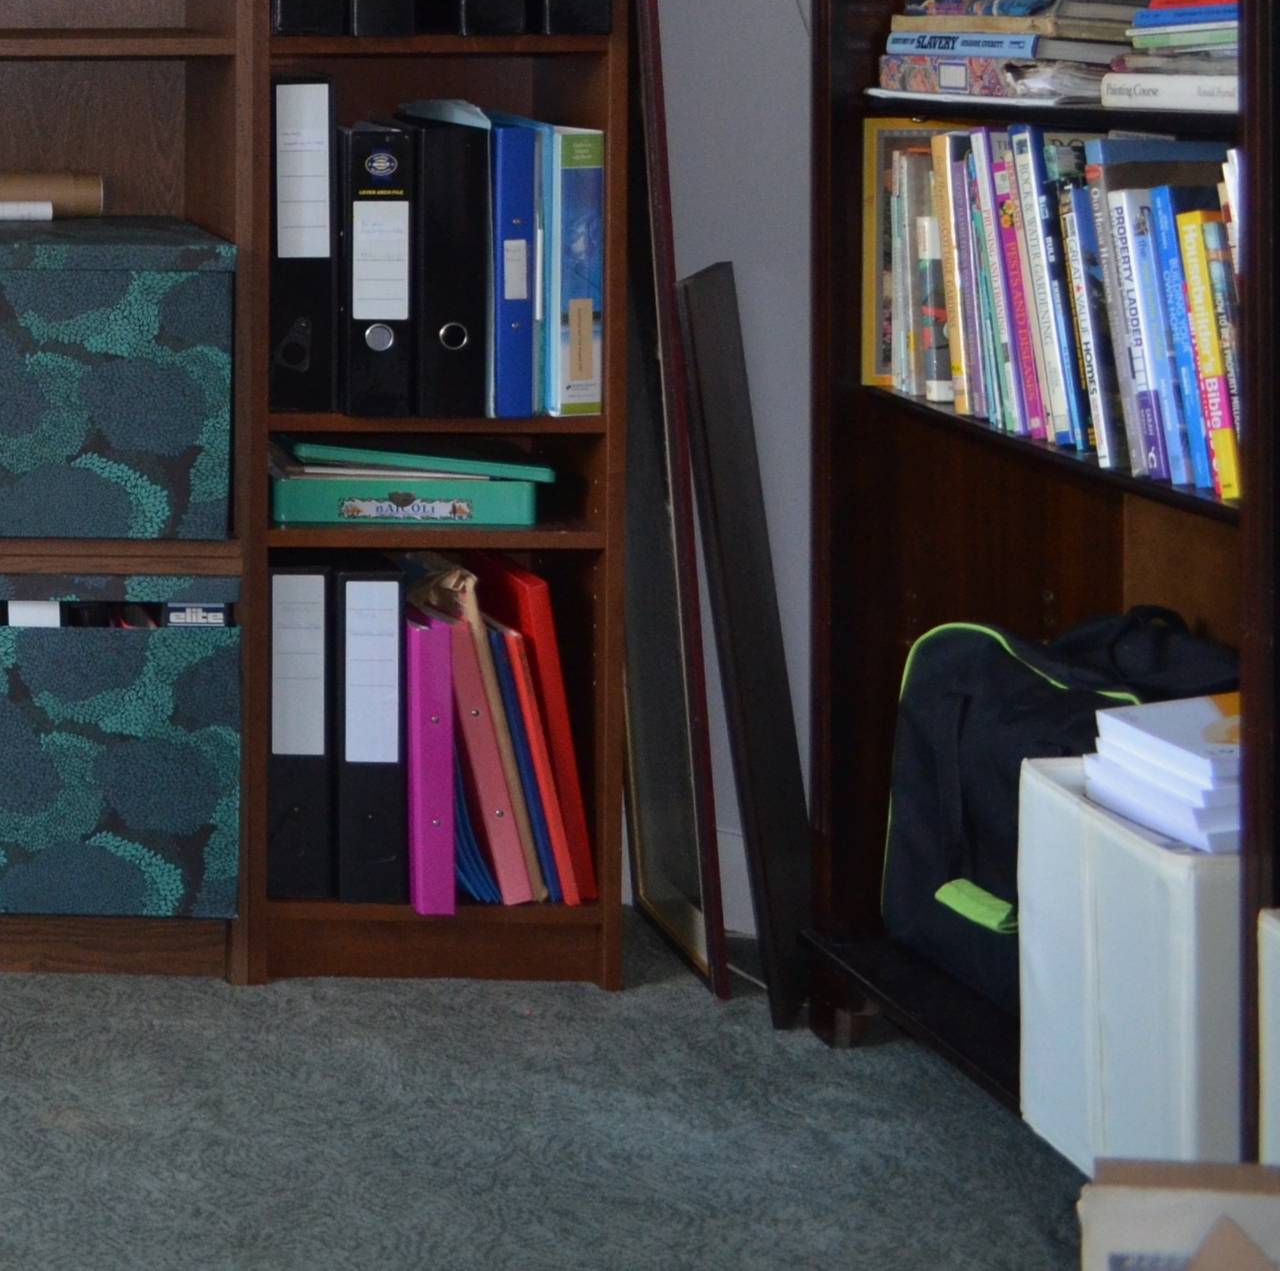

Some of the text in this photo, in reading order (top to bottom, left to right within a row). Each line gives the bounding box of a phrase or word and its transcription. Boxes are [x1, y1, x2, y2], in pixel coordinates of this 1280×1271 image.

[915, 35, 959, 51] SLAVERY
[1105, 83, 1159, 98] Painting Course
[1018, 162, 1032, 198] ROCK
[1025, 216, 1042, 259] WATER
[1068, 239, 1082, 282] GREAT
[982, 209, 1007, 336] PRUNING AND TRAINING
[1114, 206, 1143, 348] PROPERTY LADDER
[1033, 264, 1053, 346] GARDENING
[1182, 223, 1215, 371] Housebuilder's
[1007, 241, 1037, 401] PESTS AND DISEASES
[1204, 378, 1223, 428] Bible
[169, 607, 224, 623] elite
